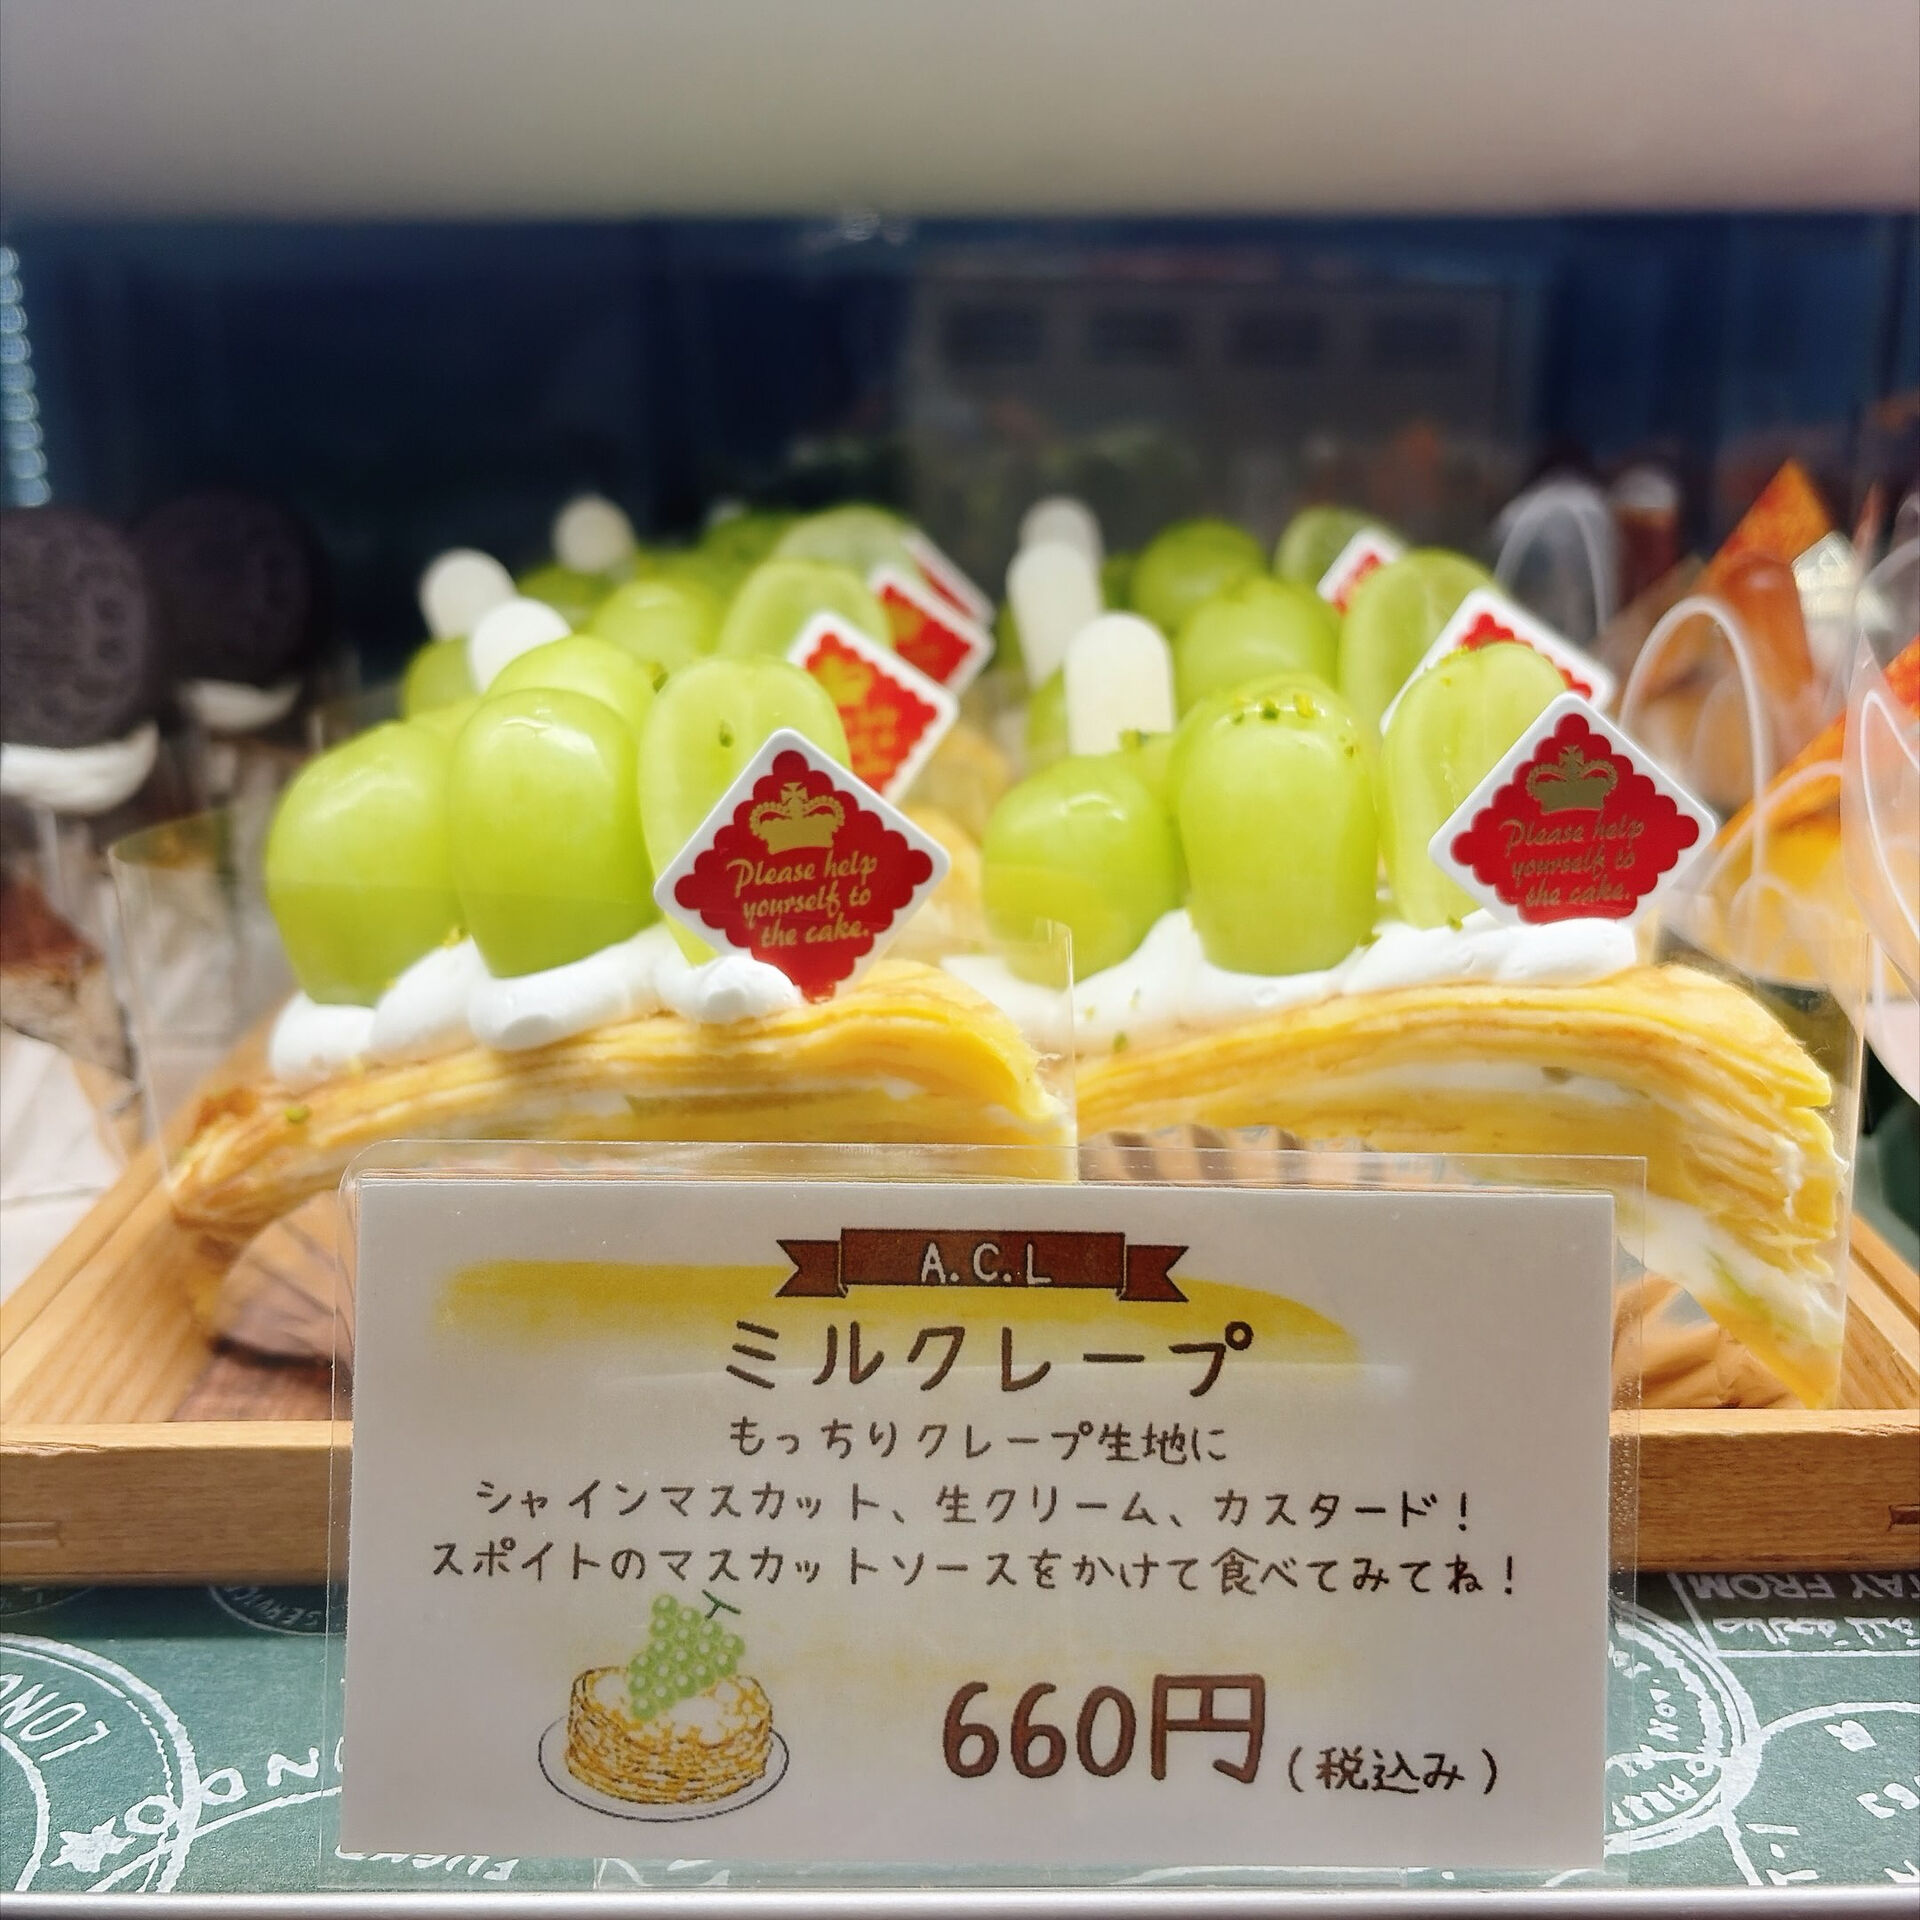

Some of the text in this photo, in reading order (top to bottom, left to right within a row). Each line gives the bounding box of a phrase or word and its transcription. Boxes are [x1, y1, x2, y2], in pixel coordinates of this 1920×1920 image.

[1499, 813, 1645, 858] Please help
[726, 850, 878, 898] Please help
[1512, 844, 1636, 888] yourself to
[743, 880, 872, 930] yourself to
[760, 911, 869, 948] the cake.
[921, 1242, 1052, 1285] A.C.L
[726, 1320, 1254, 1397] ミルクレープ
[730, 1416, 1228, 1465] もっちりクレープ生地に
[433, 1537, 1514, 1597] スポイトのマスカットソースをかけて食べてみてね！
[1686, 1574, 1836, 1600] FROM
[943, 1673, 1498, 1795] 660円 （税込み）
